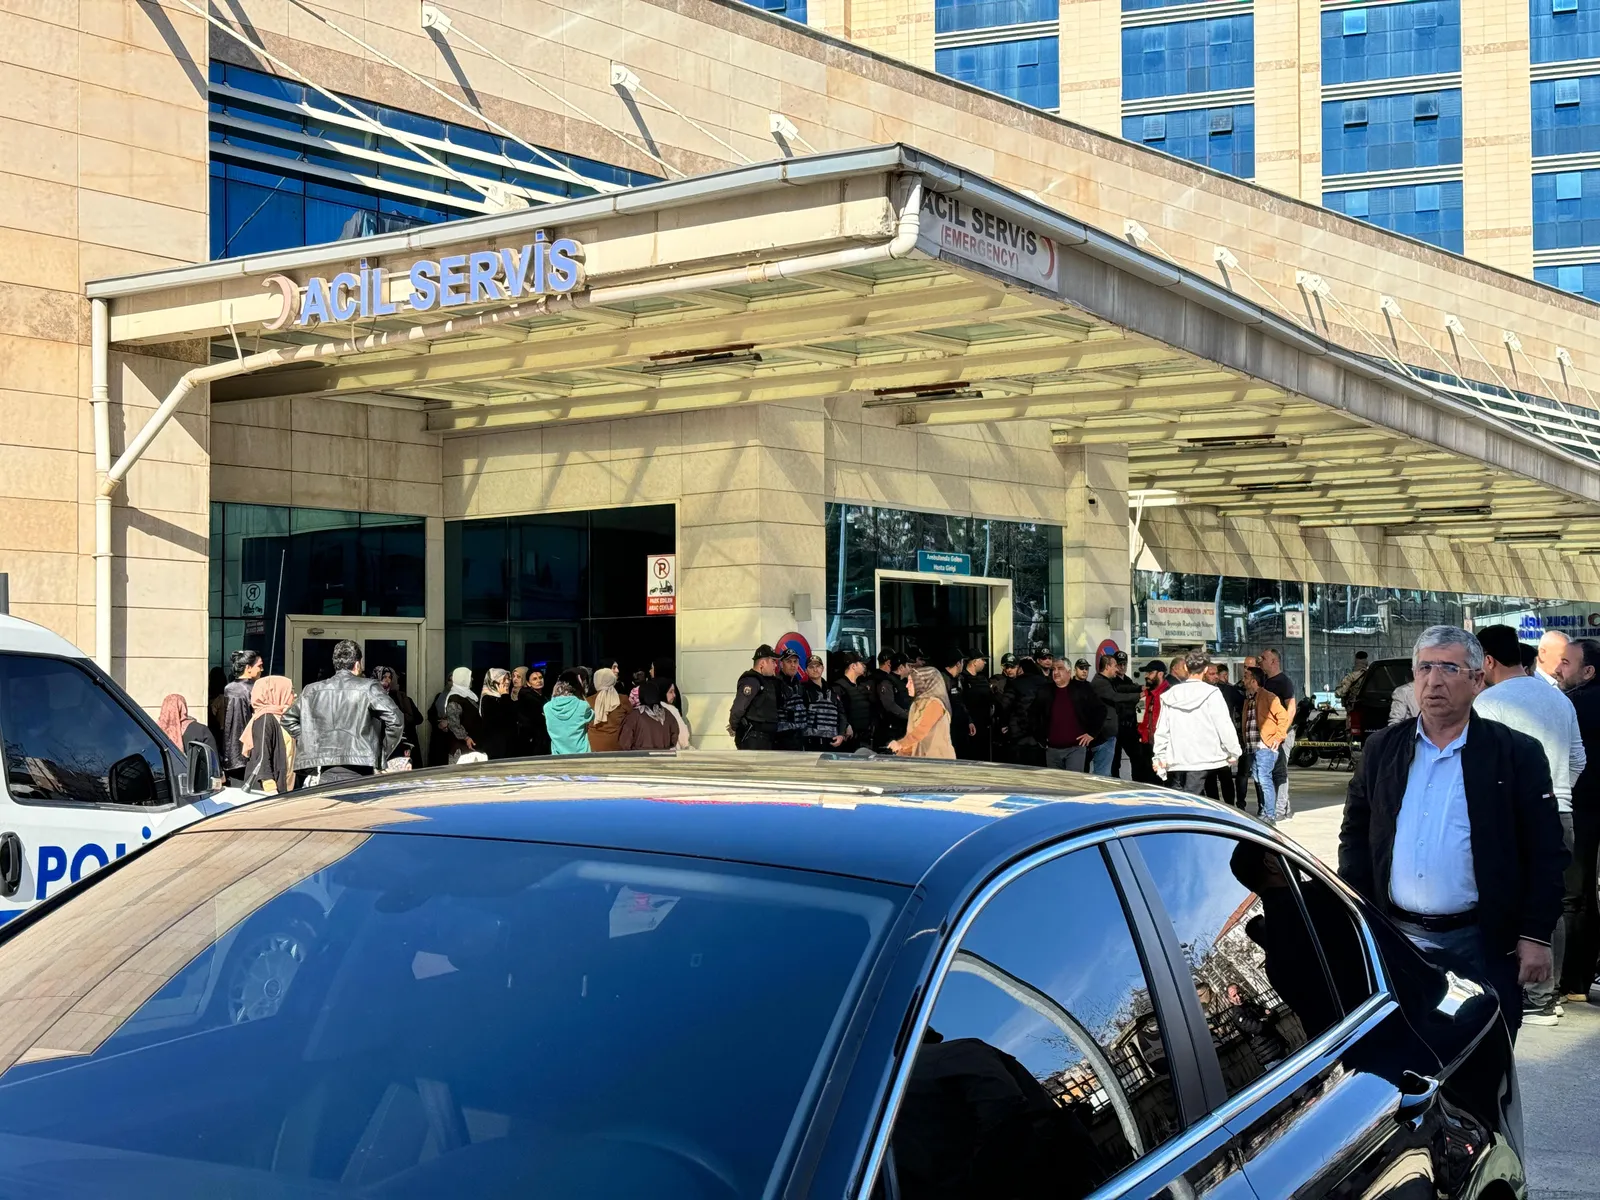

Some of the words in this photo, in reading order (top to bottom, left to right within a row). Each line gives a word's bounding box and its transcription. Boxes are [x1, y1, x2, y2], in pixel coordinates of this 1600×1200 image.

[921, 187, 966, 227] ACİL
[972, 208, 1037, 255] SERVİS
[940, 224, 1020, 273] (EMERGENCY)
[300, 257, 401, 326] ACİL
[409, 229, 586, 311] SERVİS
